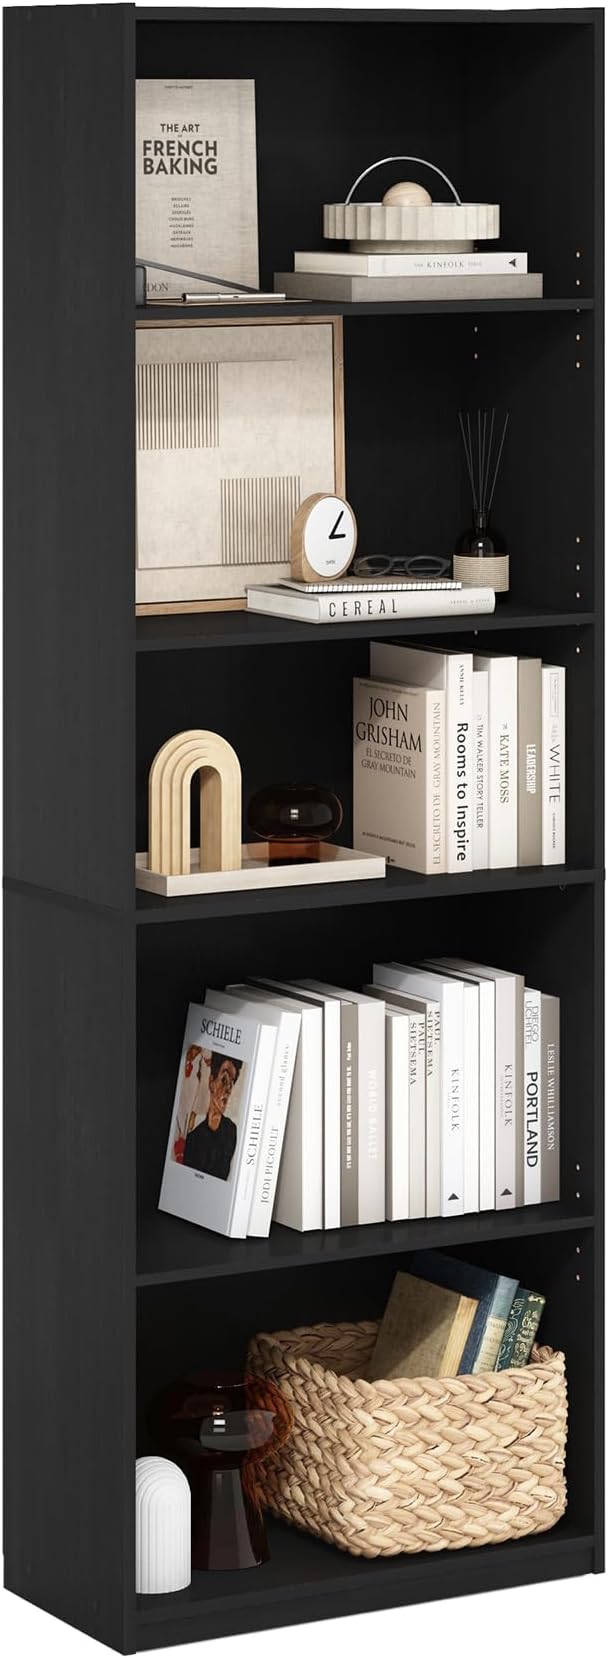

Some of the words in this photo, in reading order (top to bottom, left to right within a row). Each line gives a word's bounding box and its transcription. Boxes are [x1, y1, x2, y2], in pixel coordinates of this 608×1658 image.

[160, 124, 179, 133] THE
[182, 124, 200, 133] ART
[143, 140, 218, 156] FRENCH
[143, 158, 218, 175] BAKING
[426, 260, 465, 268] KINFOLK
[329, 599, 398, 617] CEREAL
[369, 697, 408, 722] JOHN
[356, 721, 422, 752] GRISHAM
[432, 702, 441, 761] MOUNTAIN
[366, 748, 374, 757] EL
[374, 749, 402, 764] SECRETO
[402, 754, 412, 766] DE
[457, 722, 469, 778] Rooms
[476, 740, 484, 774] WALKER
[500, 734, 509, 767] KATE
[361, 758, 379, 769] GRAY
[379, 762, 416, 779] MOUNTAIN
[432, 763, 441, 788] GRAY
[526, 744, 536, 794] LEADERSHIP
[549, 744, 560, 803] WHITE
[457, 780, 468, 801] to
[476, 775, 484, 800] STORY
[500, 770, 509, 804] MOSS
[454, 805, 469, 862] Inspire
[201, 1018, 242, 1045] SCHIELE
[530, 1006, 539, 1043] DIEGO
[451, 1069, 459, 1131] KINFOLK
[246, 1105, 263, 1166] SCHIELE
[526, 1072, 538, 1168] PORTLAND
[264, 1127, 280, 1174] PICOULT
